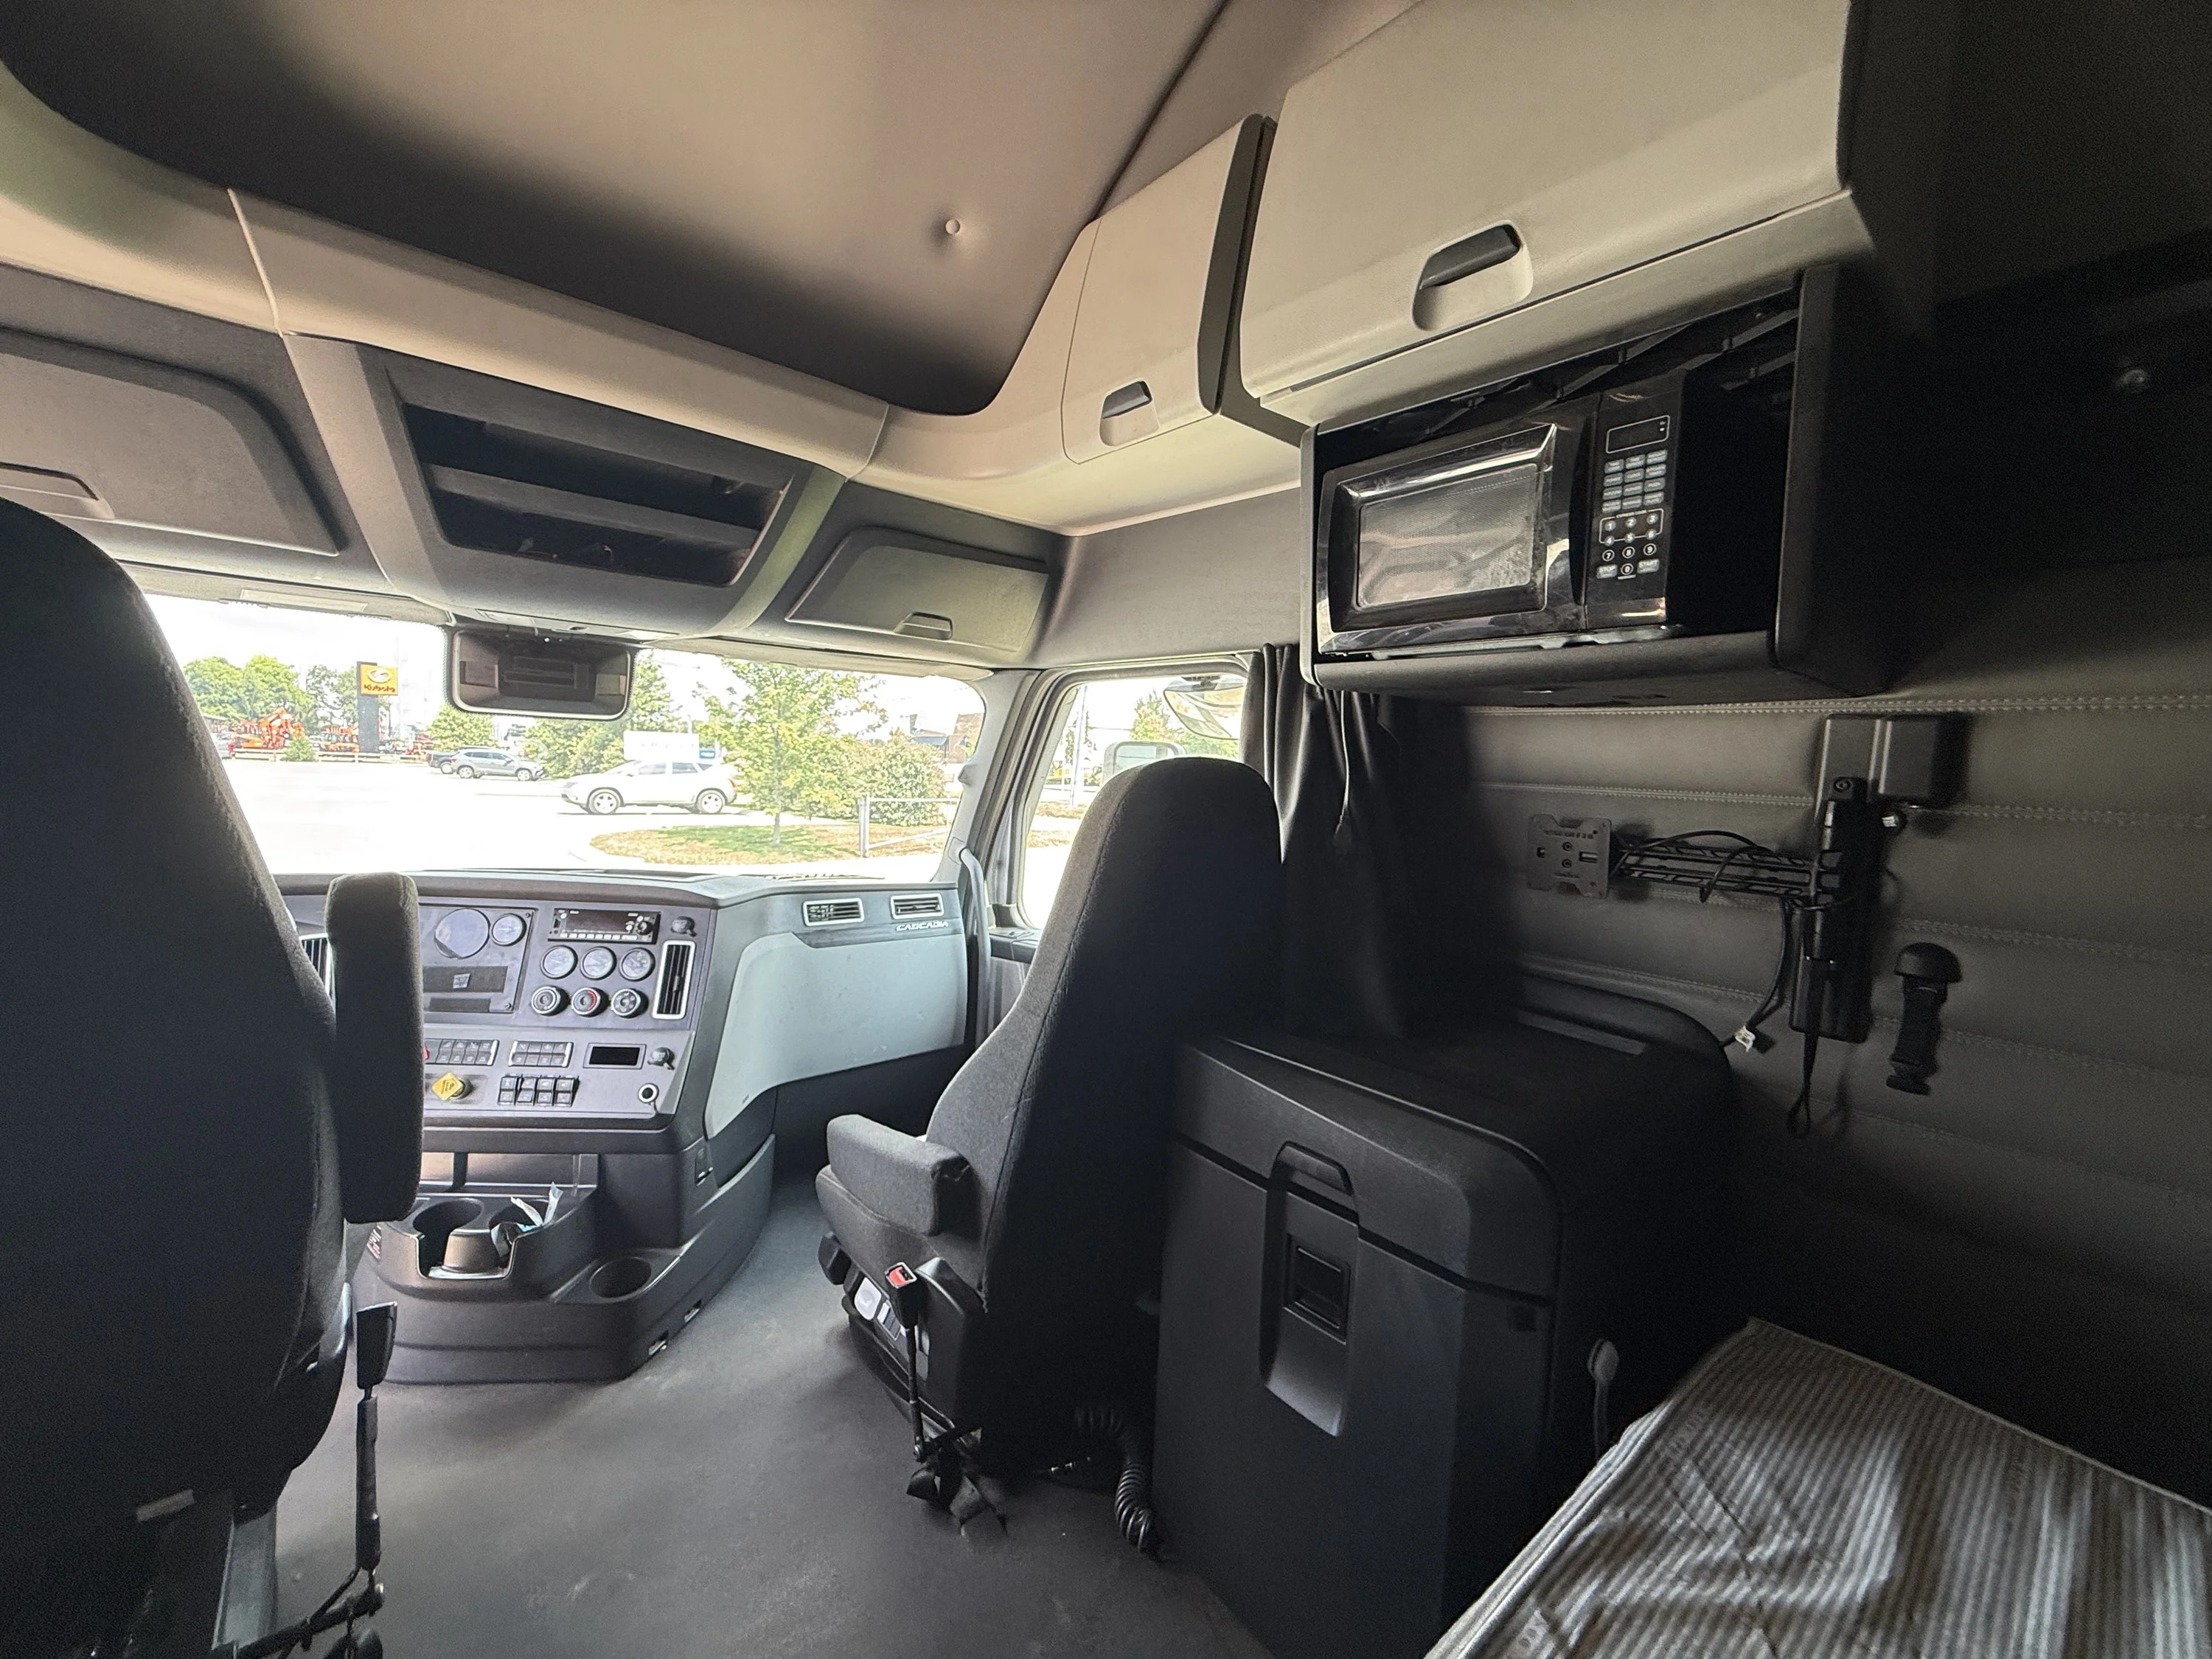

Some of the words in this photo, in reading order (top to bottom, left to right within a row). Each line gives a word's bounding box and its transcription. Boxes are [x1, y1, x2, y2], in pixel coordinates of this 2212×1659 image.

[1638, 560, 1658, 568] START
[364, 684, 396, 692] Kubota
[896, 921, 949, 931] CASCADIA
